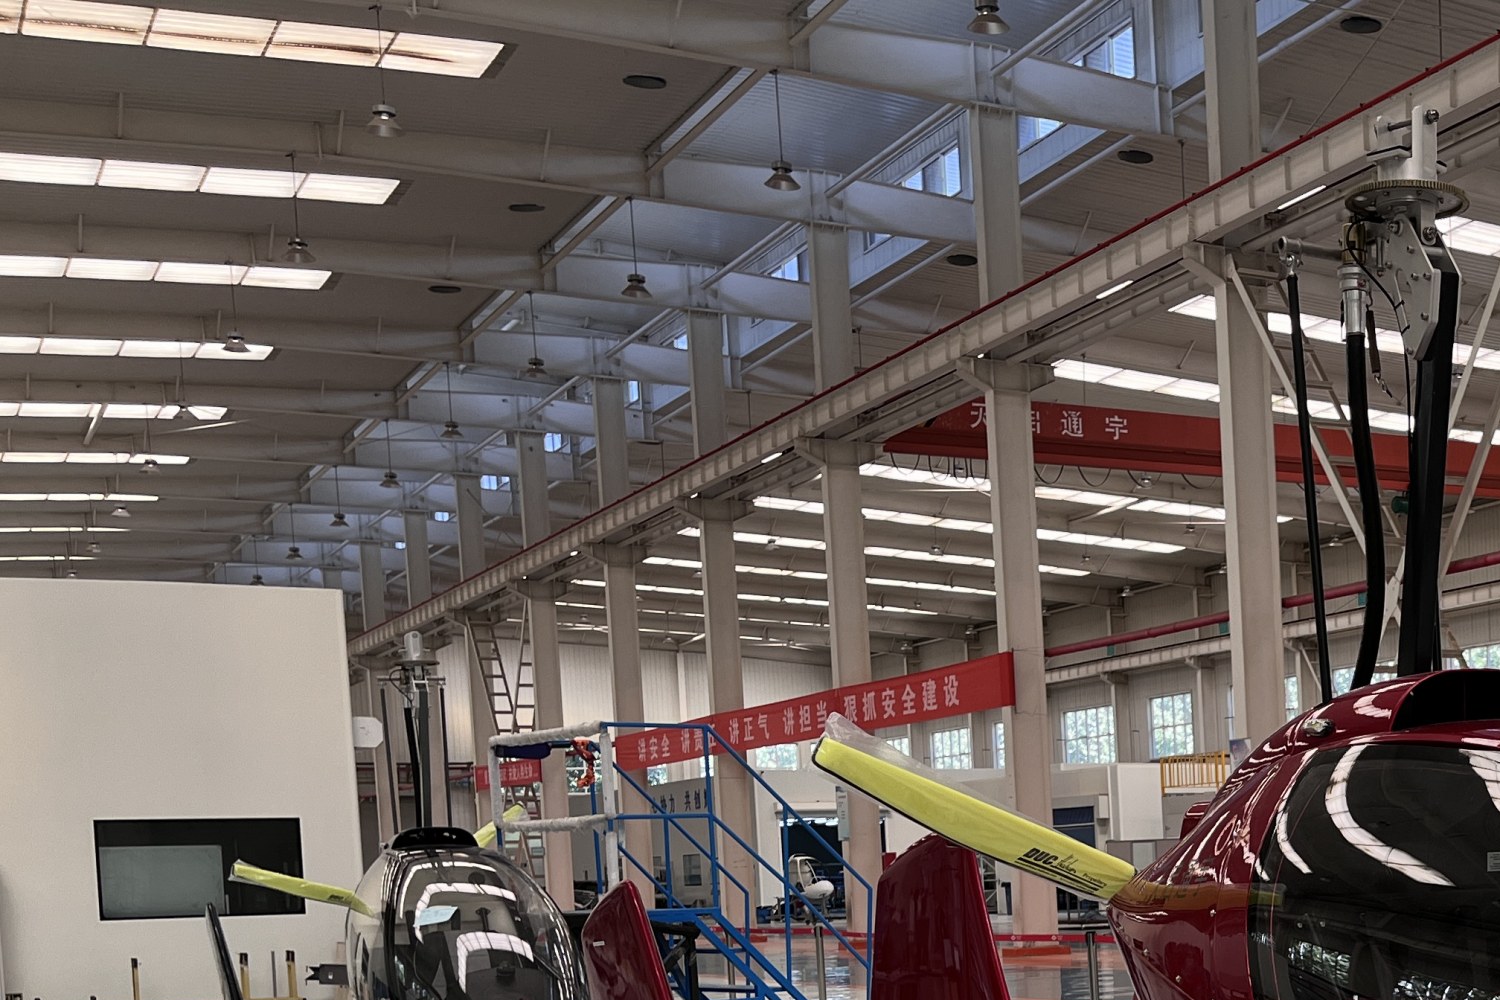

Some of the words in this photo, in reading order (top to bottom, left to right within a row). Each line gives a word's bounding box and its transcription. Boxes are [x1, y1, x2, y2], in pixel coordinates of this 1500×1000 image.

[971, 402, 1129, 440] 天通宇
[638, 733, 670, 762] 讲安全
[729, 712, 770, 744] 讲正气
[782, 700, 827, 736] 讲担当
[844, 675, 960, 722] 狠抓安全建设
[1023, 847, 1058, 865] DUC
